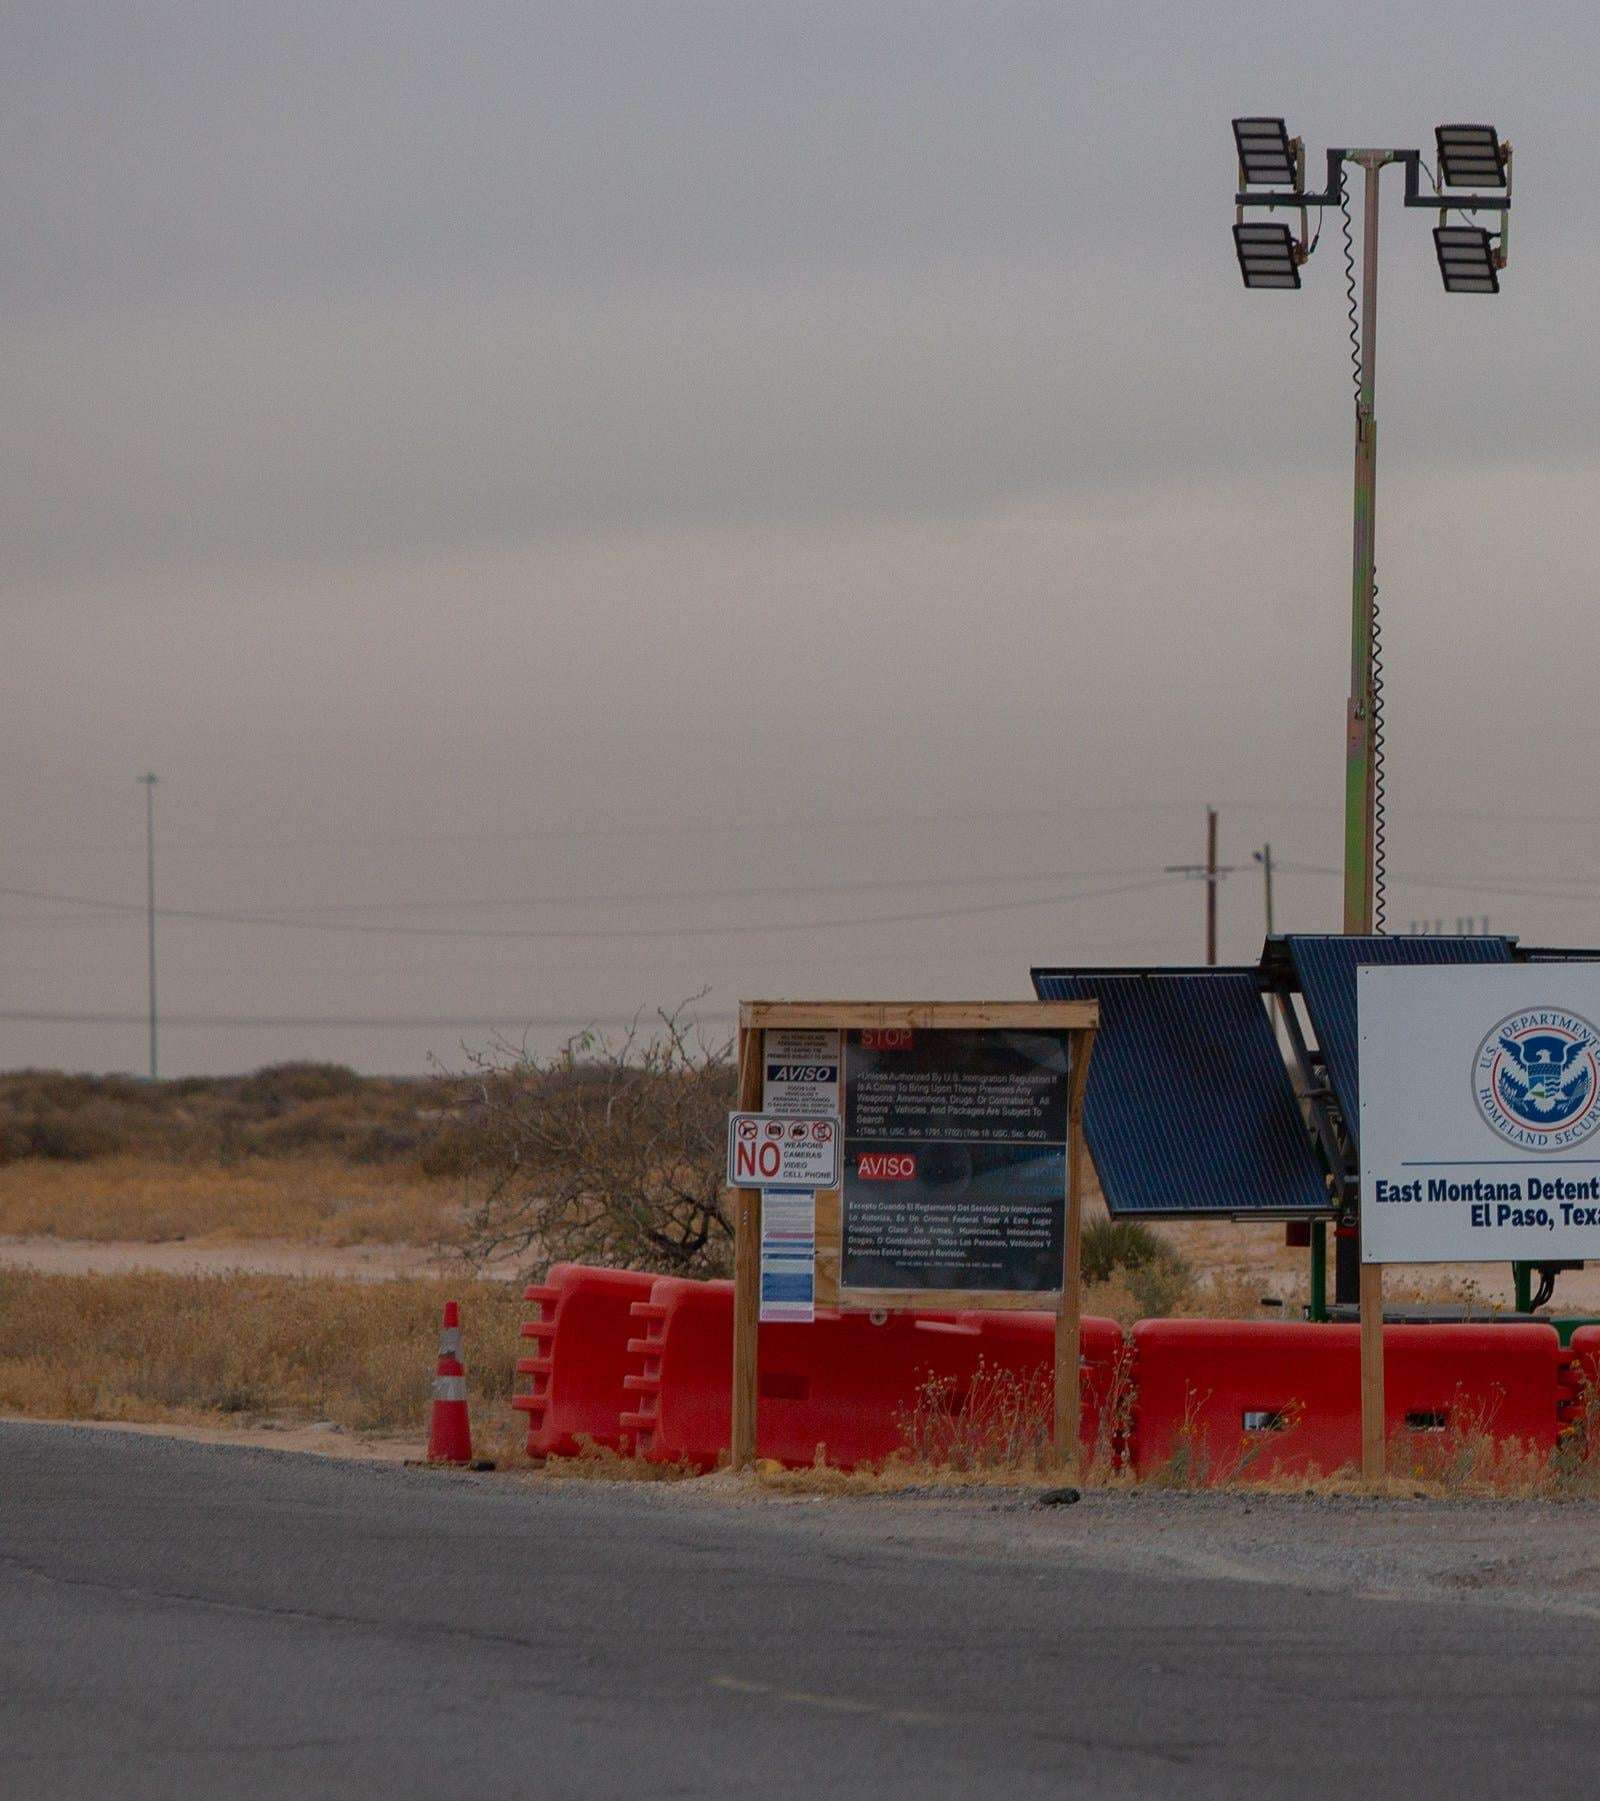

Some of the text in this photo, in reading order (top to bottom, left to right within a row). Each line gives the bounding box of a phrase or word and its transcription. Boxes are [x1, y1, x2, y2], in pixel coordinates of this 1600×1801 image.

[862, 1029, 913, 1047] STOP
[1480, 1046, 1501, 1069] U.S.
[1501, 1013, 1600, 1048] DEPARTMENT
[774, 1066, 831, 1081] AVISO
[1009, 1074, 1051, 1086] Regulation
[1016, 1086, 1032, 1096] Any
[947, 1106, 986, 1117] Packages
[1002, 1106, 1031, 1118] Subject
[1032, 1107, 1043, 1117] To
[1480, 1088, 1548, 1145] HOMELAND
[737, 1141, 781, 1177] NO
[783, 1151, 823, 1159] CAMERAS
[784, 1161, 808, 1169] VIDEO
[857, 1157, 915, 1176] AVISO
[1375, 1180, 1422, 1203] East
[1428, 1179, 1522, 1202] Montana
[1471, 1204, 1492, 1227] El
[1497, 1204, 1555, 1231] Paso,
